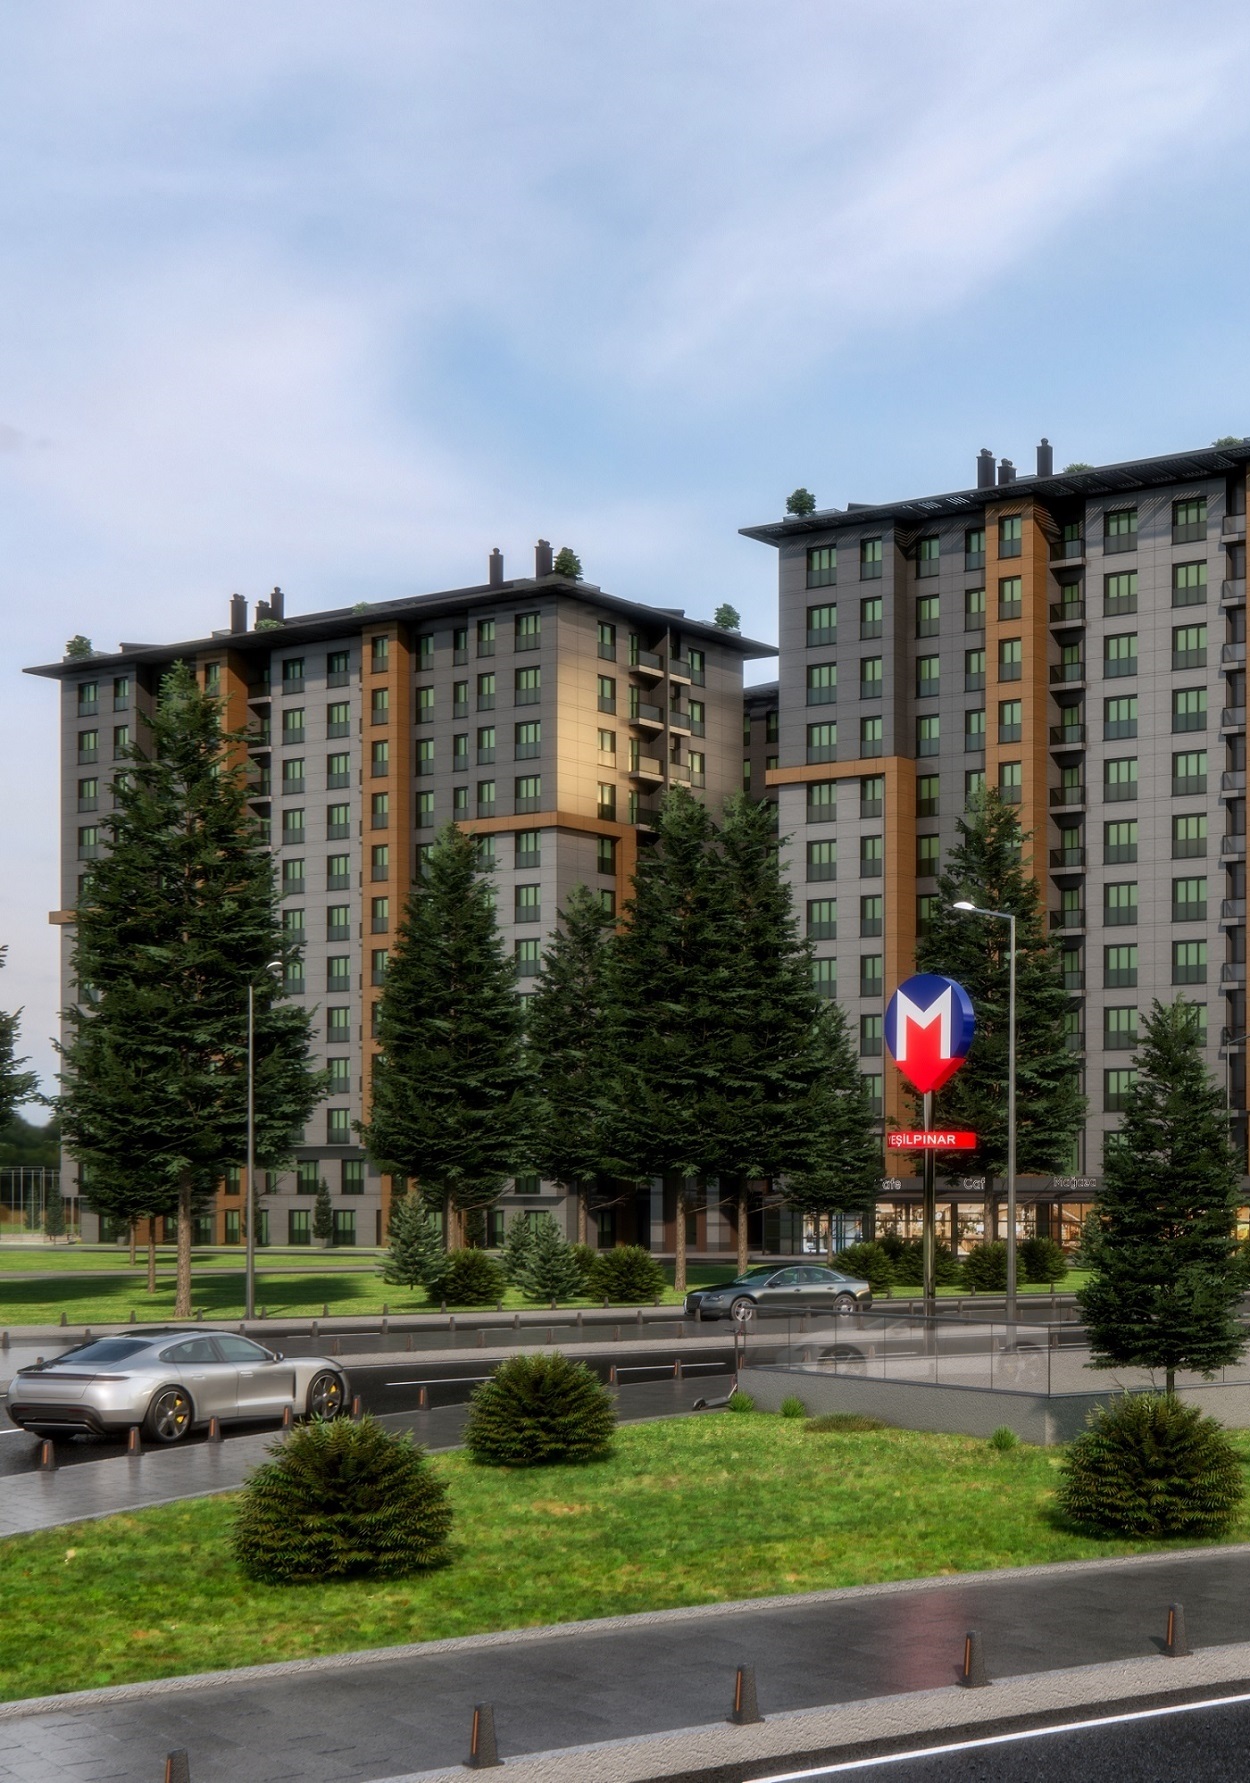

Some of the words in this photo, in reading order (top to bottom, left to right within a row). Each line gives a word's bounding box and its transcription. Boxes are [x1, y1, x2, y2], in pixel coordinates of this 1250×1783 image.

[896, 985, 952, 1061] M
[888, 1134, 956, 1147] YEŞİLPINAR
[874, 1178, 902, 1190] afe
[963, 1177, 986, 1190] Caf
